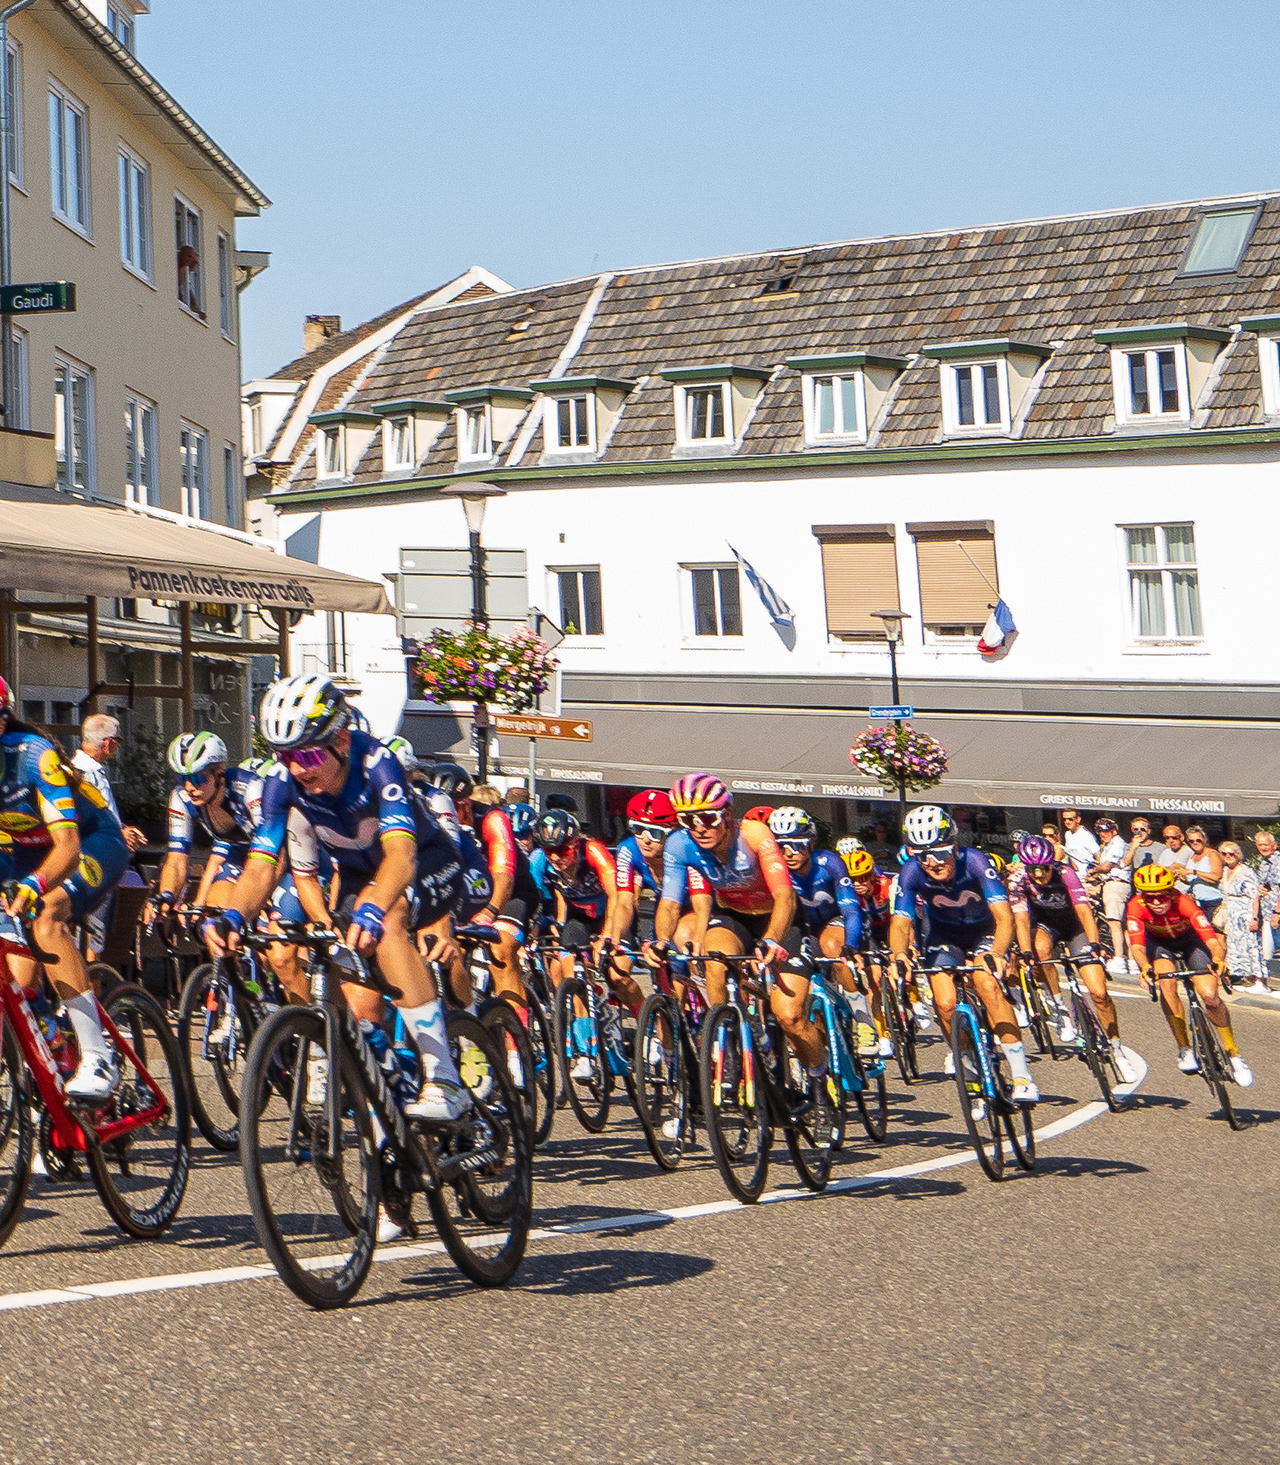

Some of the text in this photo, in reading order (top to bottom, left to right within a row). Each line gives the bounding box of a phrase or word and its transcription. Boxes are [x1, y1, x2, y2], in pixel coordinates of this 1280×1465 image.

[12, 294, 54, 310] Gaudi
[126, 566, 315, 608] Pannenkoekenparadijs
[760, 781, 815, 793] RESTAURANT
[821, 784, 884, 798] THESSALONIKI
[1040, 794, 1226, 813] GRIEKS RESTAURANT THESSALONIKI
